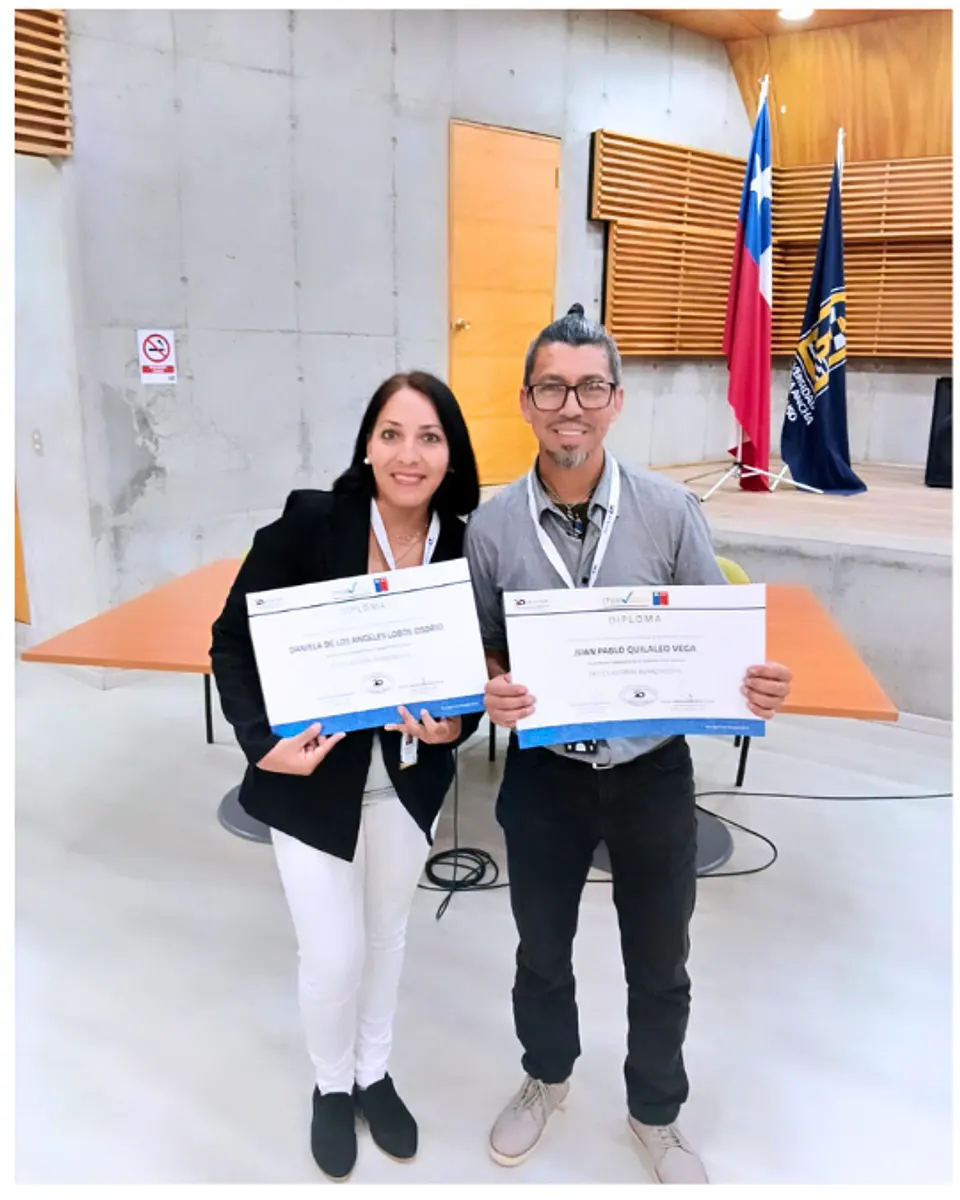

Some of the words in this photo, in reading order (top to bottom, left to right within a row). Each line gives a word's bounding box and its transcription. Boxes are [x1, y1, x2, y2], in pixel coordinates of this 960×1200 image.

[608, 614, 662, 625] DIPLOMA
[288, 642, 323, 655] DANIELA
[387, 628, 413, 640] LOBOS
[574, 647, 597, 657] JUAN
[597, 646, 626, 655] PABLO
[625, 644, 671, 655] QUILALEO
[671, 644, 697, 653] VEGA
